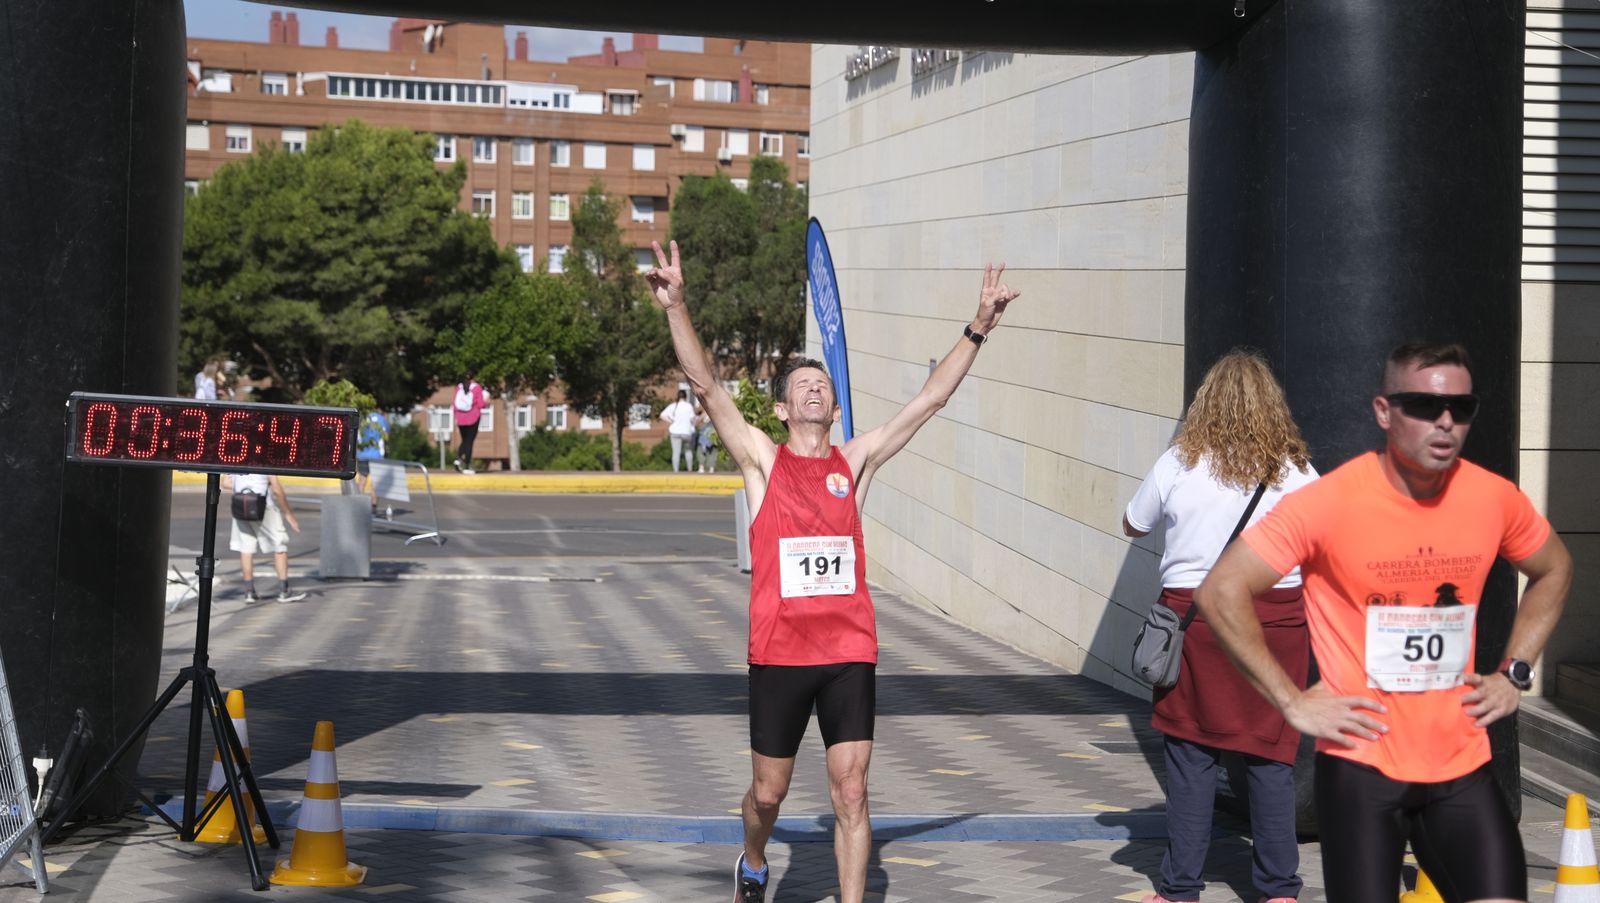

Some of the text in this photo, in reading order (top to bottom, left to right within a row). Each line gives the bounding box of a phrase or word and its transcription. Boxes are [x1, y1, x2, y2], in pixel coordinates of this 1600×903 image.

[84, 403, 344, 465] 00:36:47
[799, 556, 841, 576] 191
[1367, 560, 1420, 570] CARRERA
[1424, 555, 1483, 568] BOMBEROS
[1433, 565, 1476, 575] CIUDAD
[1402, 633, 1444, 662] 50
